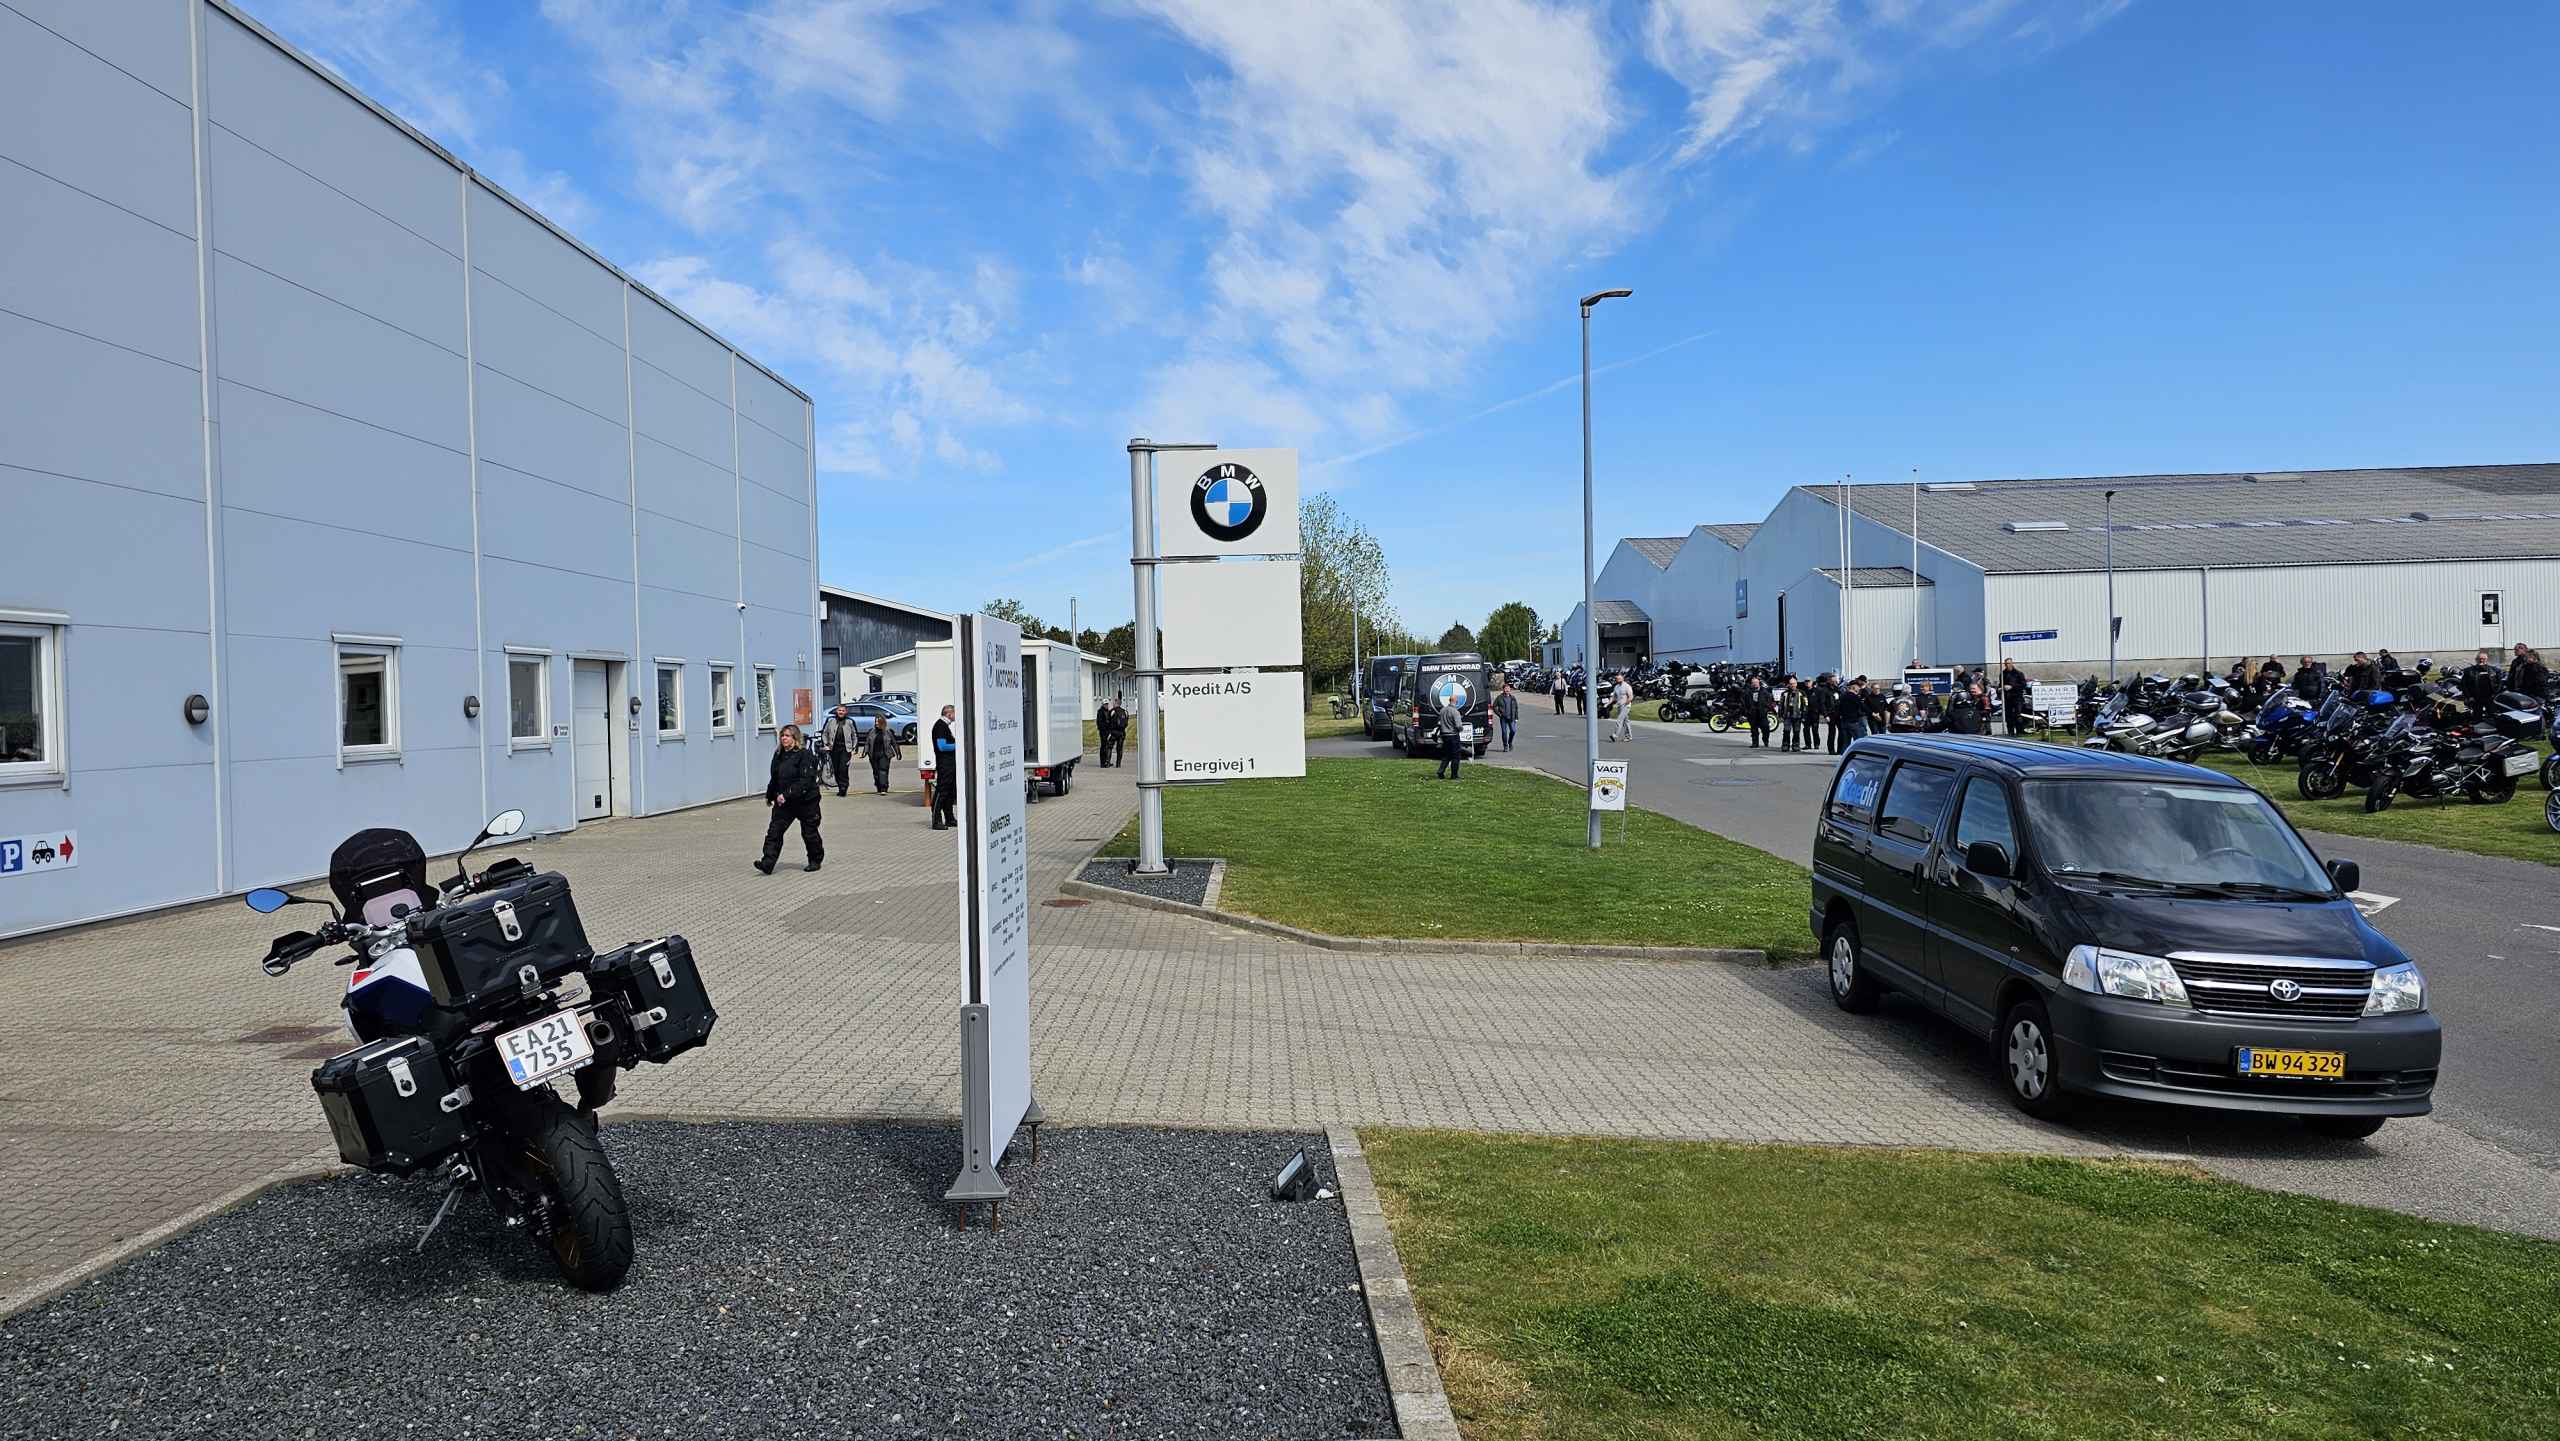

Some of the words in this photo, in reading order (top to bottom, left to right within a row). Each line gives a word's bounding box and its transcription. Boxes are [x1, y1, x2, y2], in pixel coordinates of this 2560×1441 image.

[1197, 465, 1261, 490] BMW
[1441, 663, 1481, 671] MOTORRAD
[1171, 682, 1221, 698] Xpedit
[1224, 681, 1252, 695] A/S
[1434, 674, 1472, 689] BMW
[1174, 757, 1244, 774] Energivej
[1248, 757, 1255, 770] 1
[1596, 765, 1625, 773] VAGT
[3, 843, 20, 871] P
[507, 1017, 573, 1056] EA21
[525, 1040, 573, 1073] 755
[2252, 1053, 2278, 1070] BW
[2281, 1054, 2303, 1071] 94
[2307, 1056, 2341, 1073] 329
